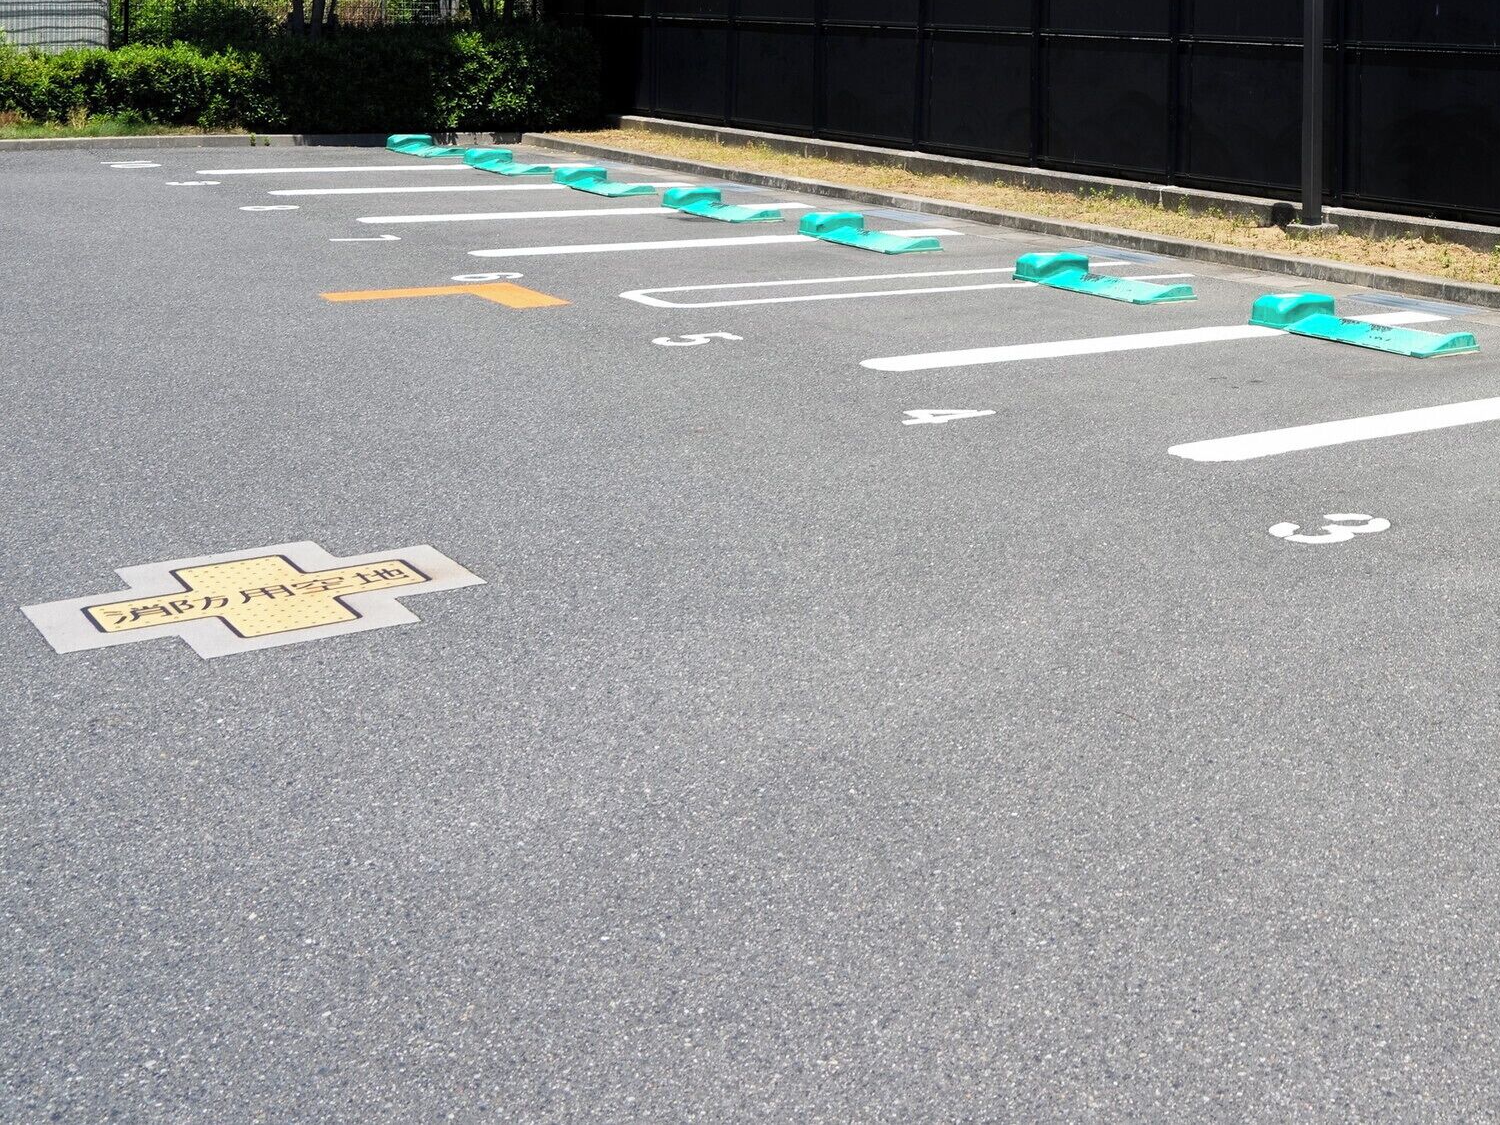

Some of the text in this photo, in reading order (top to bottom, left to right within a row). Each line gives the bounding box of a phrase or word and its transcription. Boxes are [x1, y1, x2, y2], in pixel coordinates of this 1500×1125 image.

[238, 204, 301, 212] 8
[451, 271, 525, 284] 6
[651, 330, 744, 349] 5
[901, 407, 997, 426] 4
[1268, 511, 1391, 545] 3
[103, 567, 410, 626] 消防用空地
